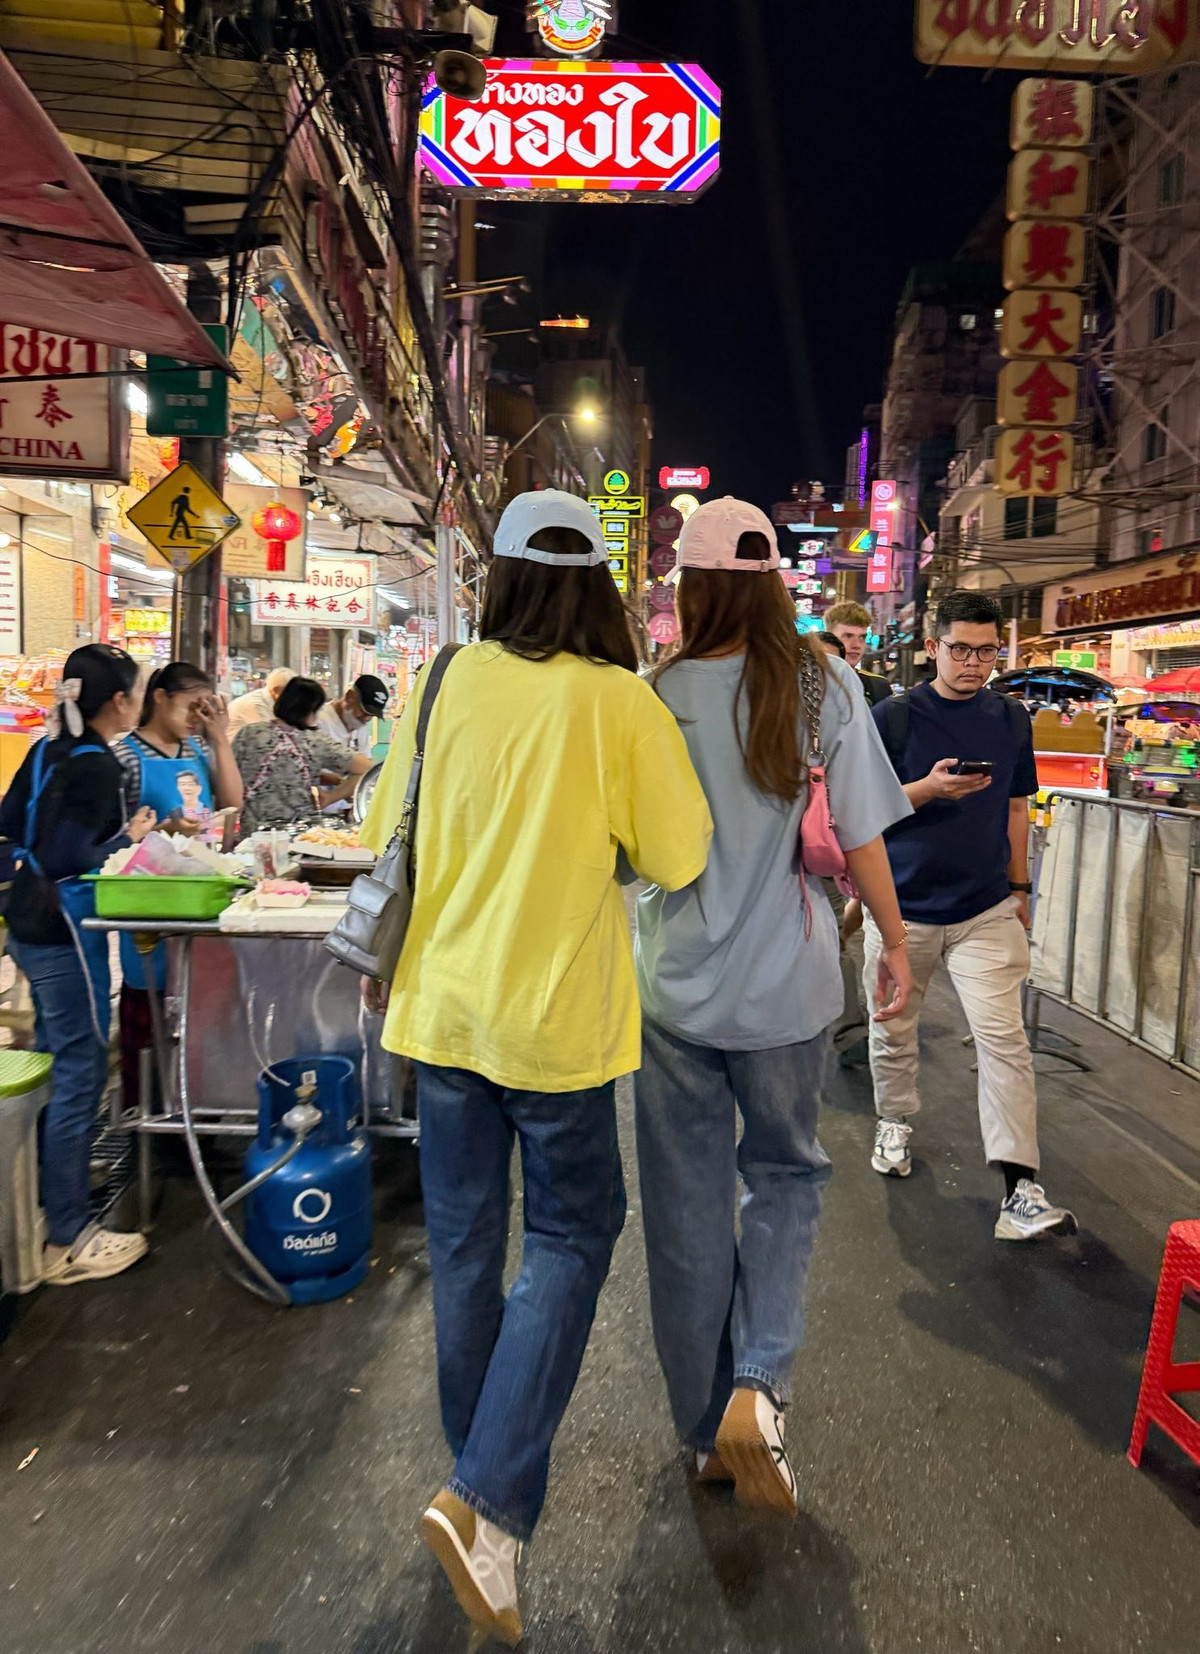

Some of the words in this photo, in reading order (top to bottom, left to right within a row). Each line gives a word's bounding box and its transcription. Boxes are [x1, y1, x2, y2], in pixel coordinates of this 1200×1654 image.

[469, 73, 584, 106] ้างทอง
[450, 81, 691, 169] ทองใบ
